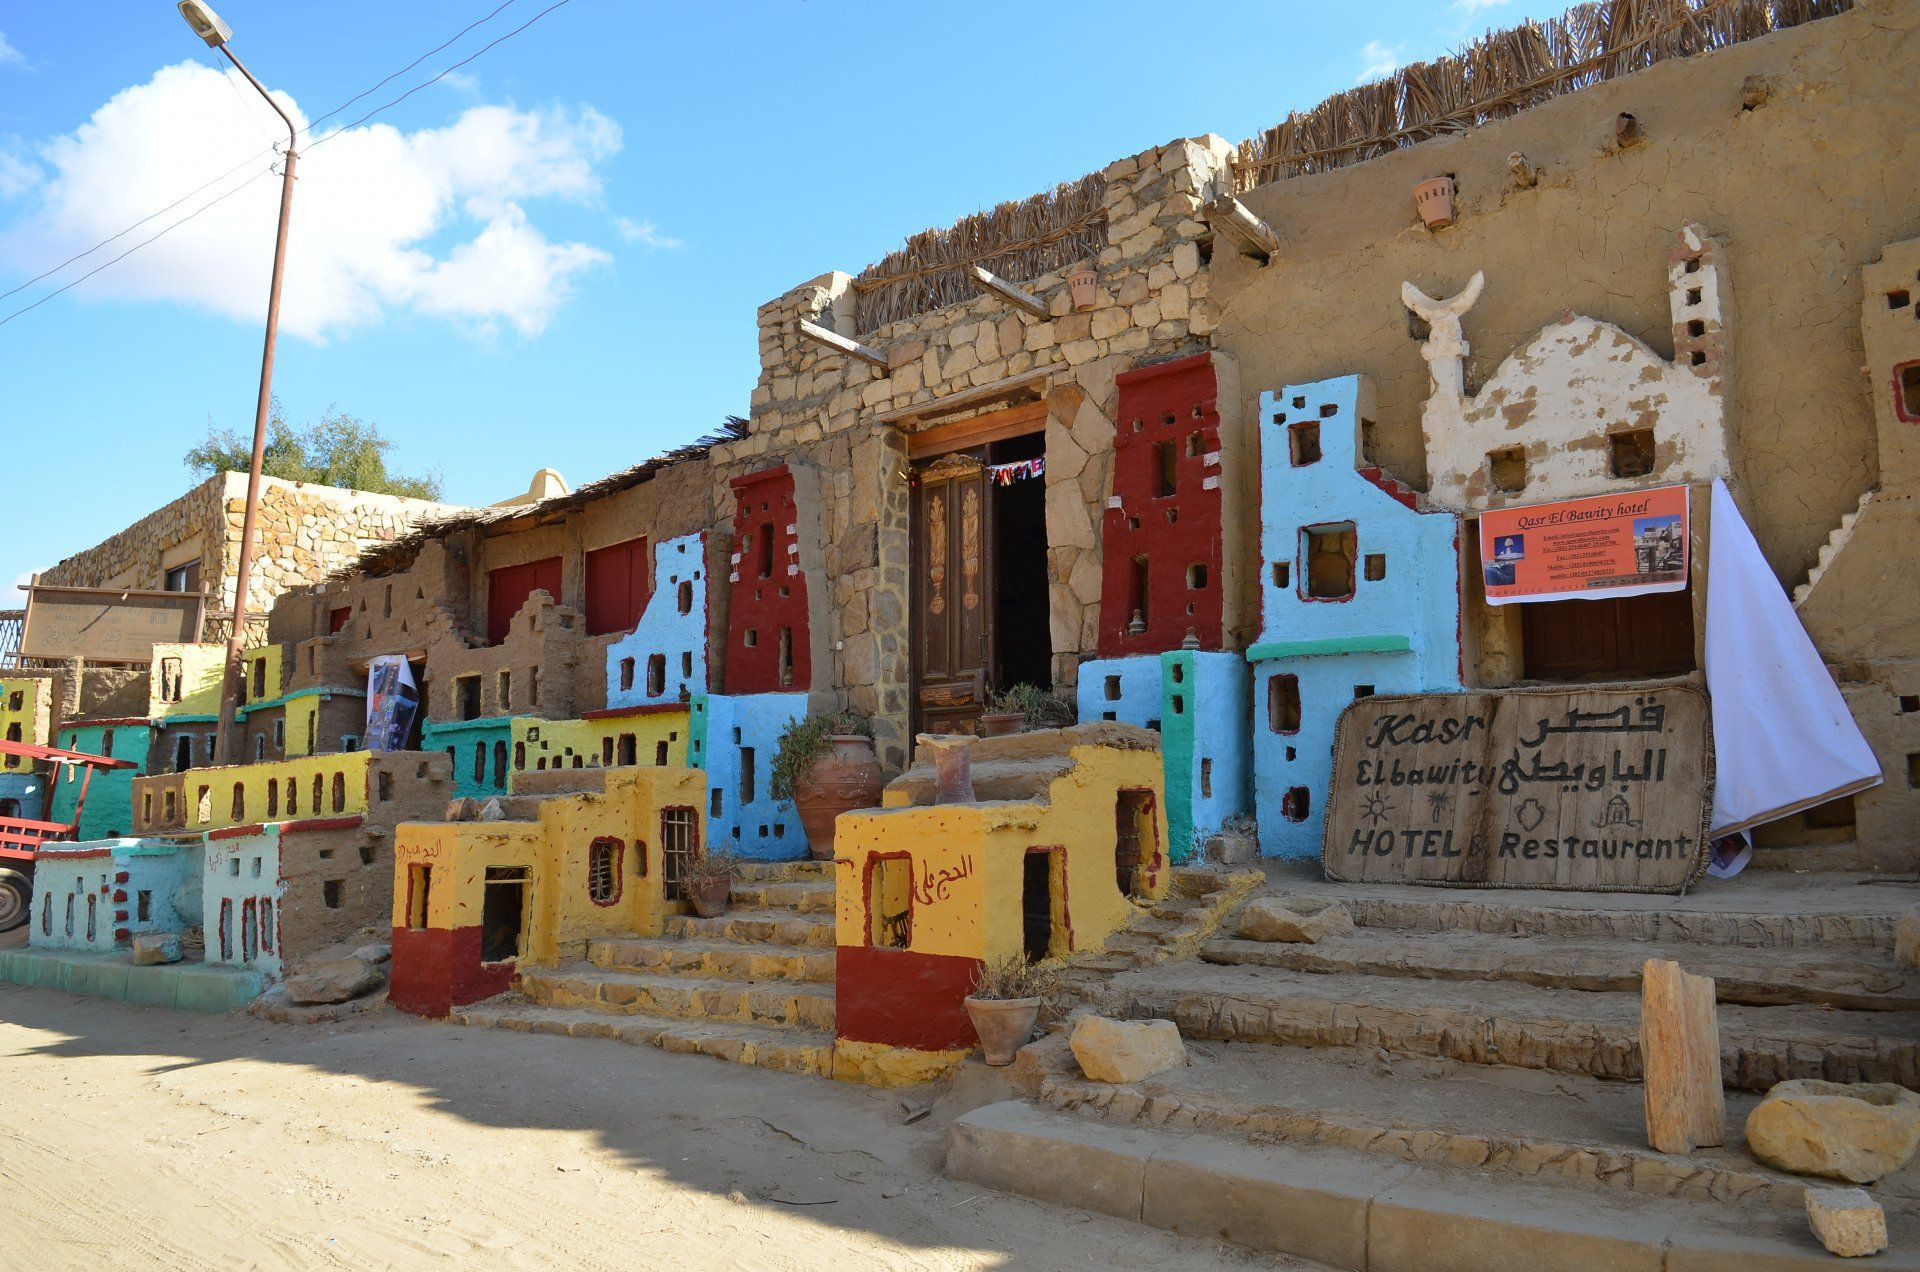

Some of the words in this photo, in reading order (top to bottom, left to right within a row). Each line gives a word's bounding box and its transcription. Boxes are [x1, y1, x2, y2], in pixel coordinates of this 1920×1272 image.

[1518, 515, 1546, 530] Qasr
[1548, 509, 1566, 524] El
[1567, 505, 1613, 521] Bawity
[1616, 499, 1651, 515] hotel
[1365, 713, 1485, 749] Kasr
[1519, 695, 1666, 748] قصر
[1355, 757, 1498, 796] Elbawity
[1348, 829, 1462, 858] HOTEL
[1497, 831, 1694, 860] Restaurant
[936, 853, 974, 901] الحج
